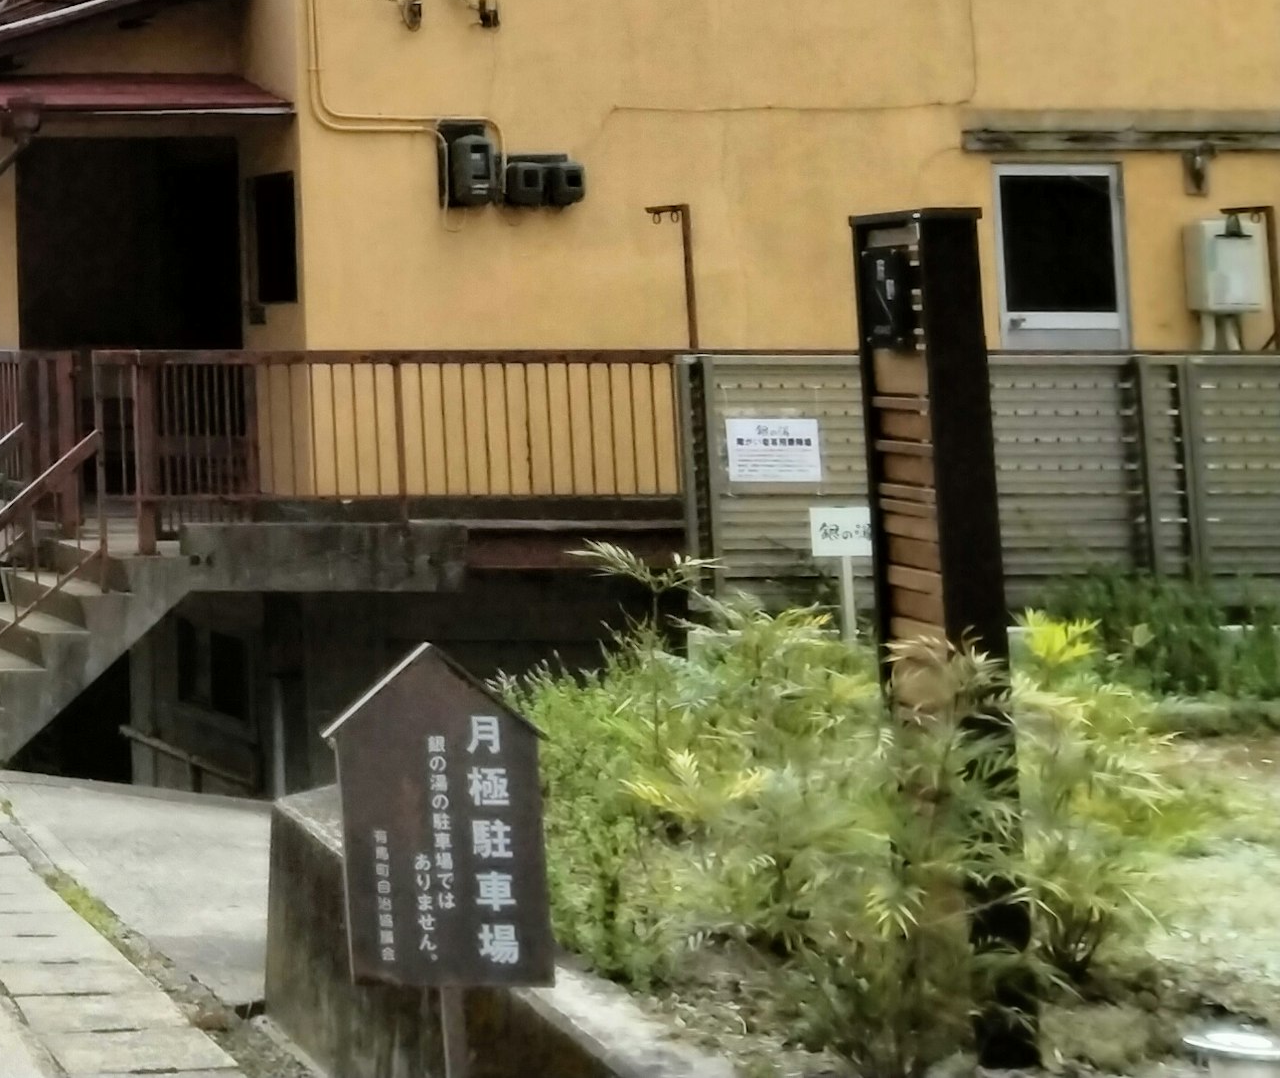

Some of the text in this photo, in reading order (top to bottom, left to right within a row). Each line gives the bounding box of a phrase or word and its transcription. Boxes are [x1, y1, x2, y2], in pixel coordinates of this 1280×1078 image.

[414, 853, 438, 961] ありません。
[427, 735, 455, 909] 銀の湯の駐車場では
[466, 715, 519, 964] 月極駐車場
